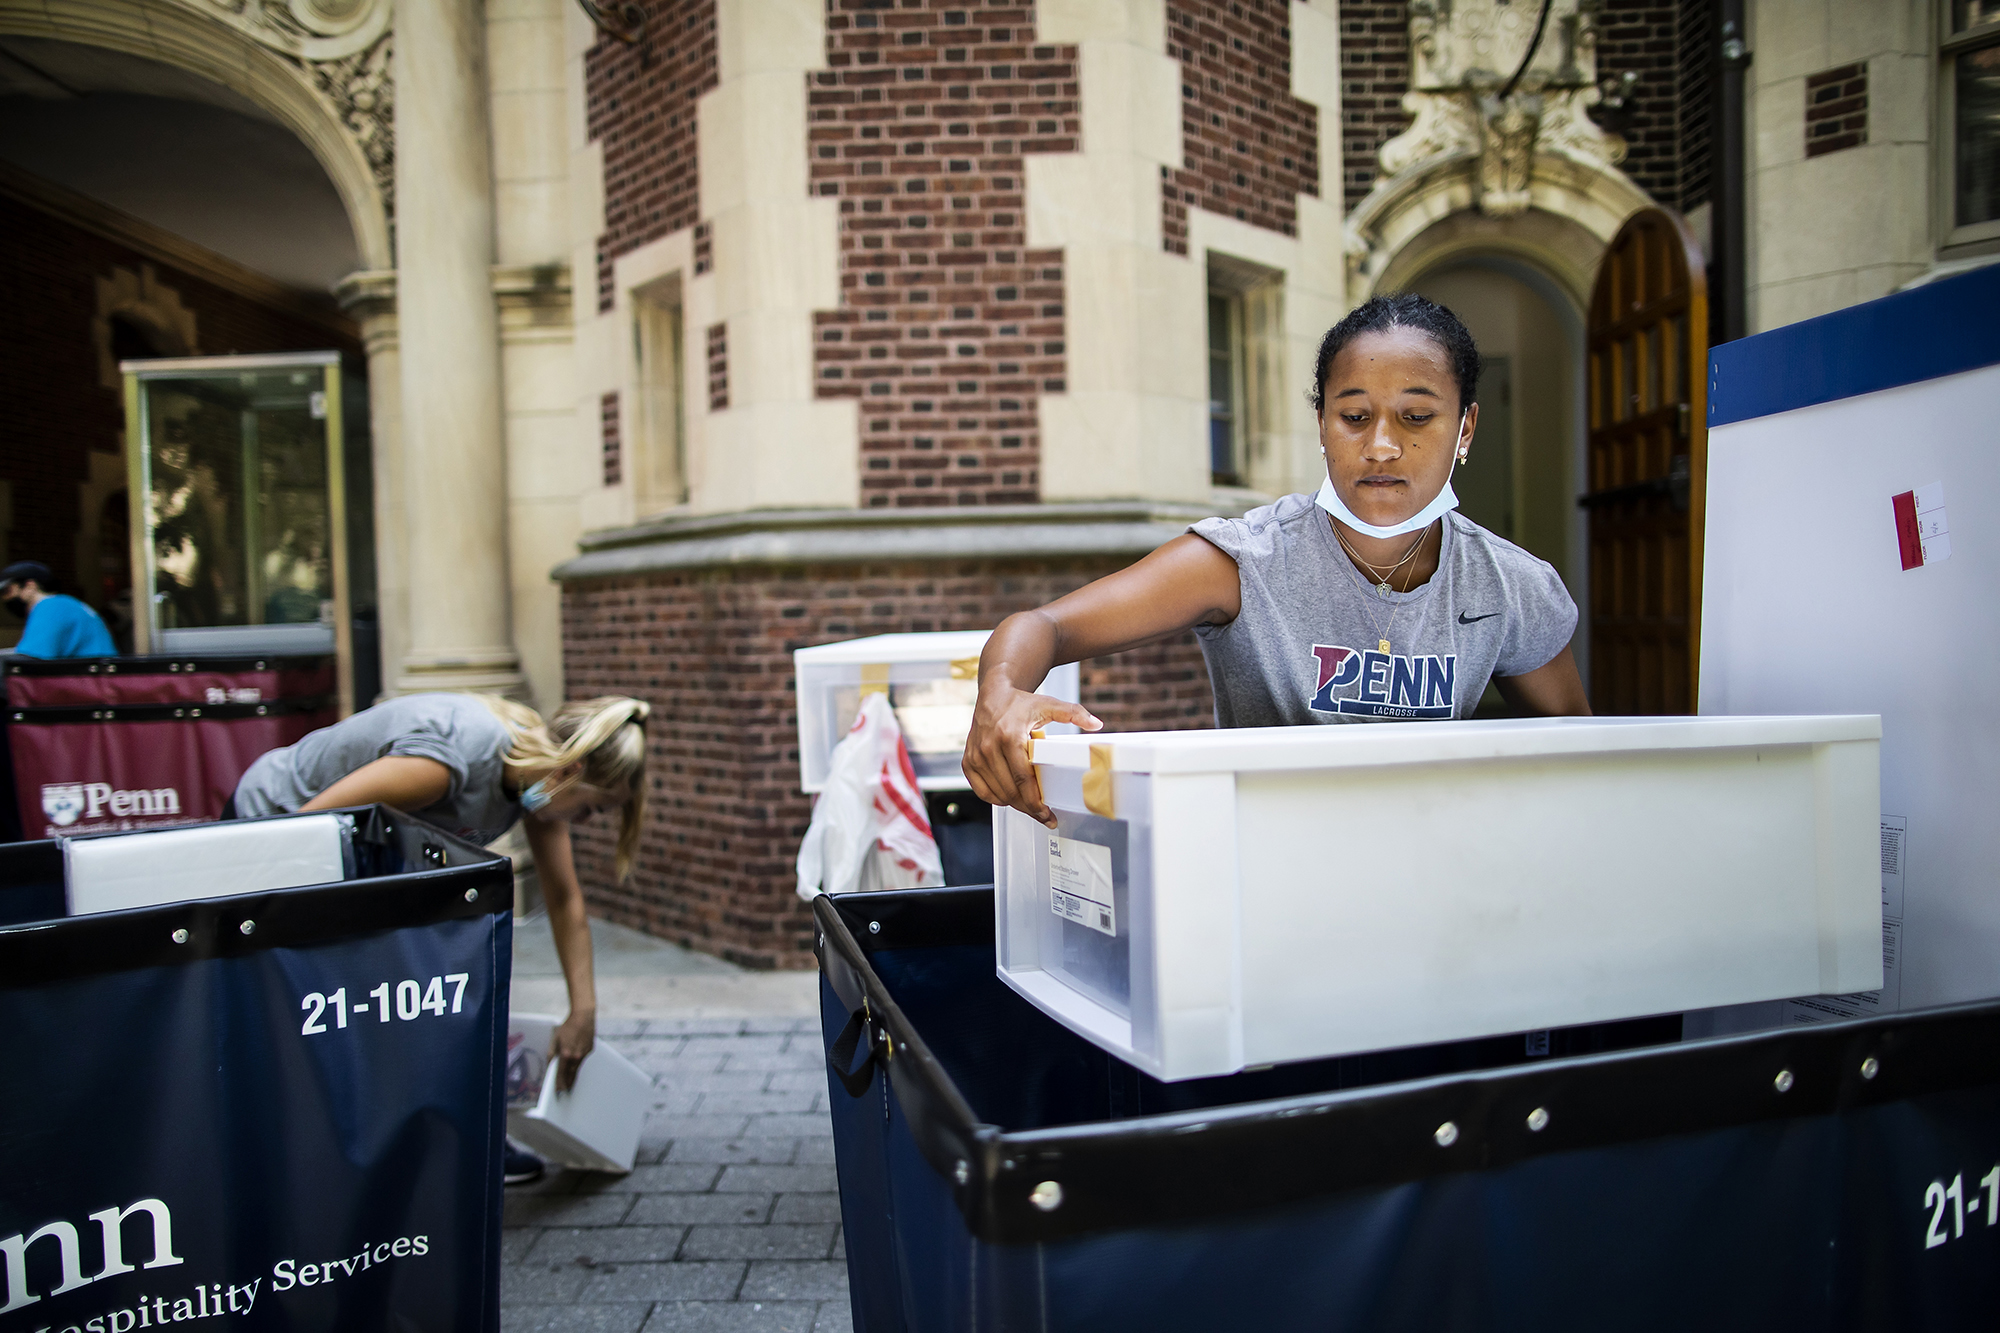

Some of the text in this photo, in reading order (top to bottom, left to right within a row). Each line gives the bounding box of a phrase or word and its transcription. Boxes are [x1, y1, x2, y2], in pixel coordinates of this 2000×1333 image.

[1308, 644, 1457, 713] PENN
[1372, 705, 1418, 717] LACROSSE
[84, 782, 181, 818] Penn
[301, 972, 470, 1036] 21-1047
[1924, 1165, 2000, 1250] 21-1
[0, 1198, 184, 1314] nn
[35, 1234, 430, 1333] spitality Services
